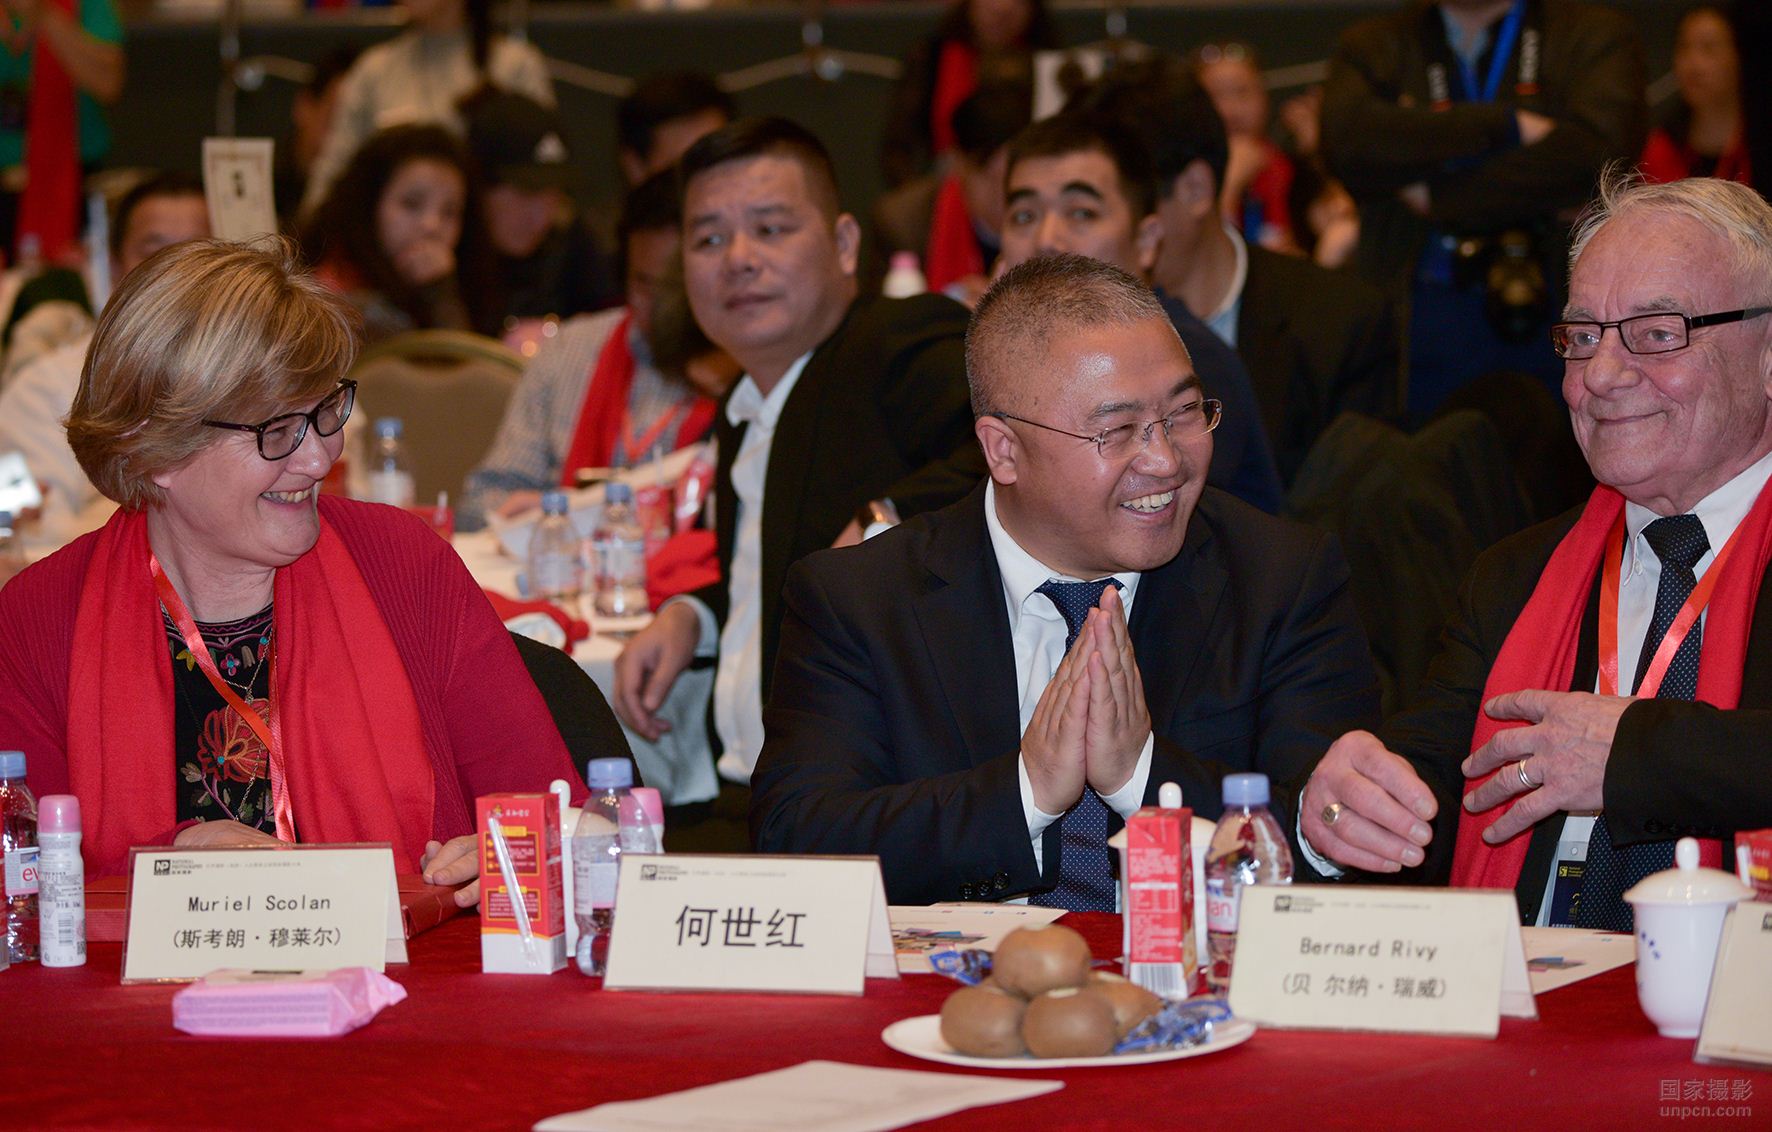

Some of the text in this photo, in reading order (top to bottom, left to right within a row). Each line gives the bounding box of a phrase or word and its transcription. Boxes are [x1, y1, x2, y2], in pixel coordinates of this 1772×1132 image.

[188, 894, 331, 912] Muriel Scolan
[675, 904, 807, 947] 何世红
[1299, 936, 1438, 962] Bernard Rivy
